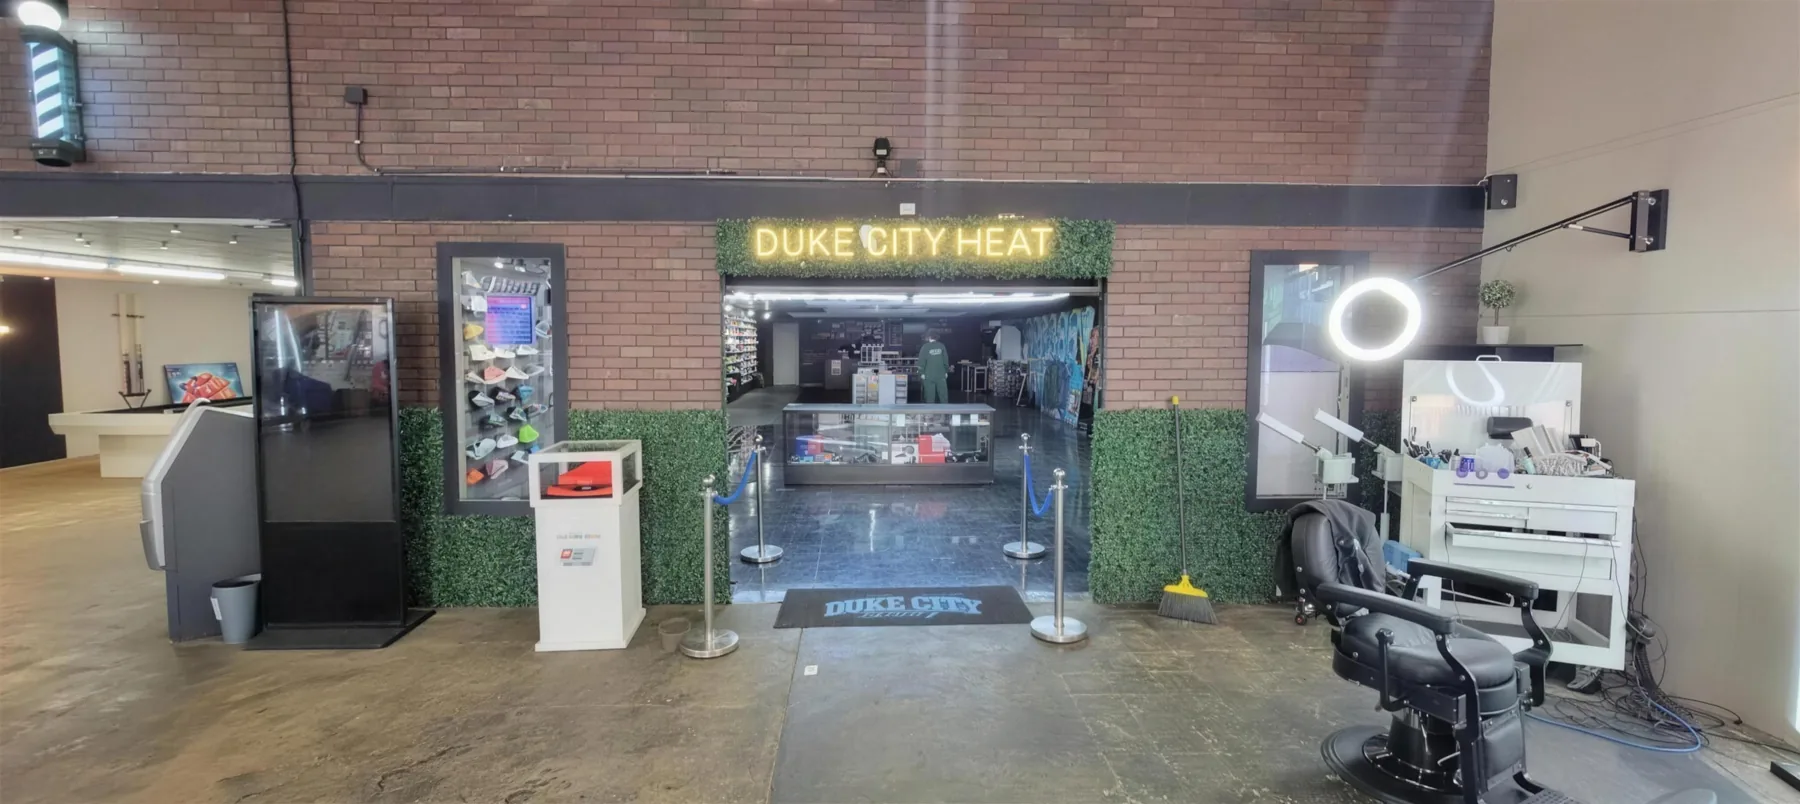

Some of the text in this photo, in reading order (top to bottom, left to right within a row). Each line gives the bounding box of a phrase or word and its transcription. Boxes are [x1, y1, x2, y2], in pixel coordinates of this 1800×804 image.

[755, 227, 1054, 257] DUKE CITY HEAT
[824, 596, 905, 617] DUKE
[911, 596, 982, 614] CITY
